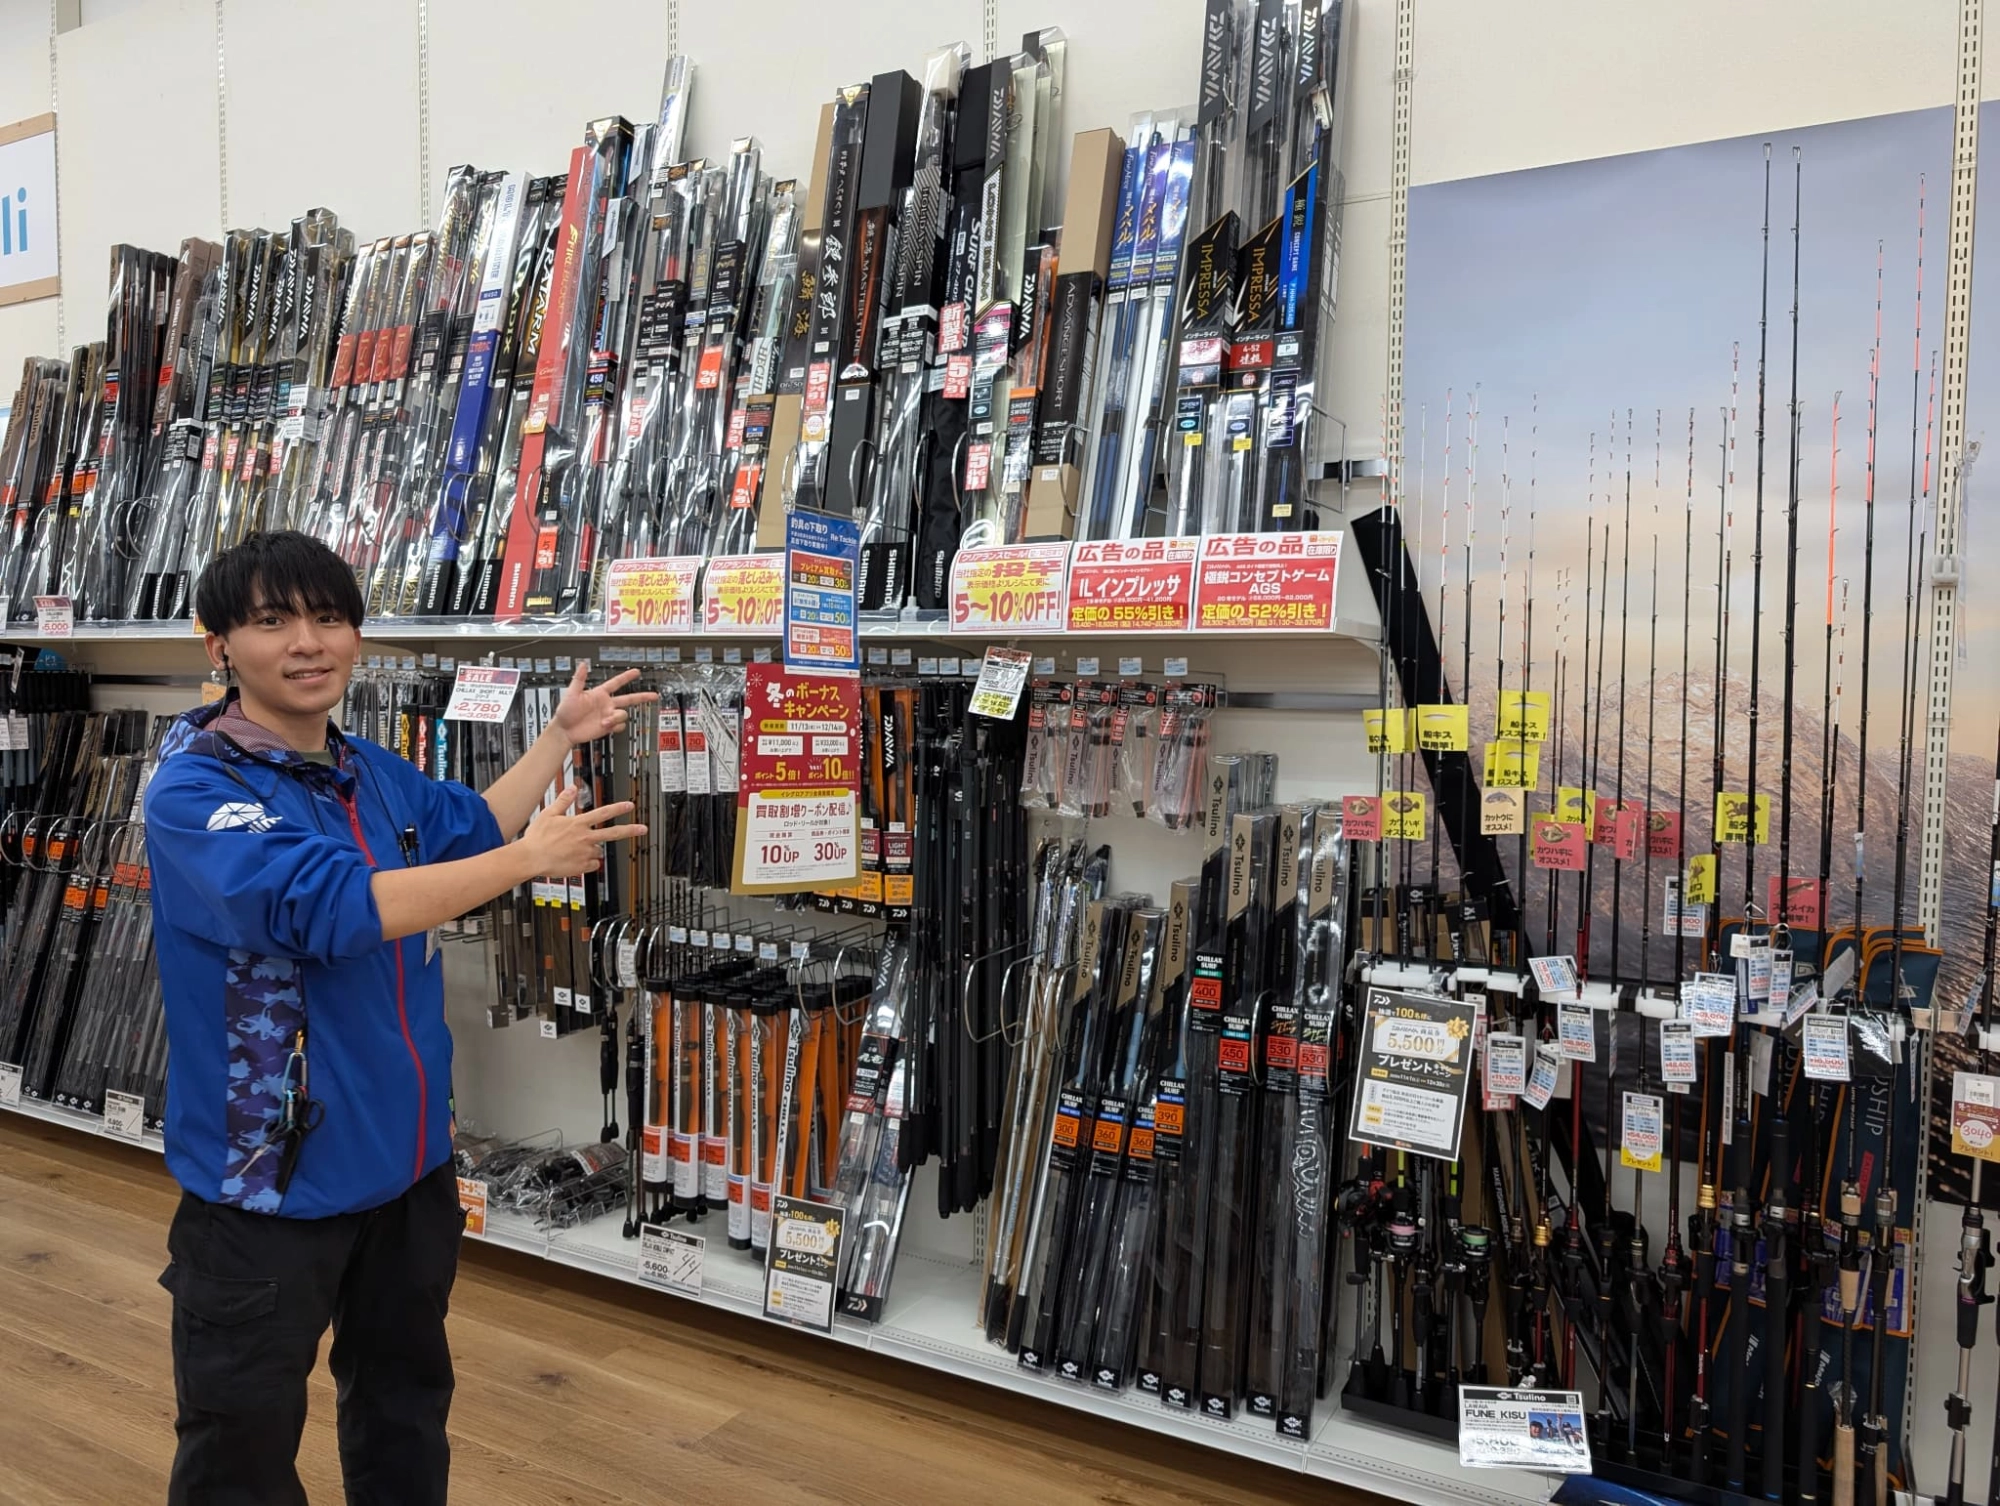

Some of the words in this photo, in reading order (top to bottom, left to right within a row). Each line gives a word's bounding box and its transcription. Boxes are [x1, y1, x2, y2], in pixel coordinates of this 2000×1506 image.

[967, 218, 981, 272] SURF
[1197, 243, 1214, 320] IMPRESSA
[1248, 248, 1266, 323] IMPRESSA
[1077, 541, 1164, 562] 広告の品
[1205, 536, 1303, 556] 広告の品
[885, 549, 897, 604] SHIMANO
[934, 550, 945, 599] SHIMANO
[1204, 569, 1329, 584] 極鋭コンセプトゲーム
[428, 564, 441, 608] SHIMANO
[480, 564, 493, 610] SHIMANO
[508, 562, 521, 608] SHIMANO
[1079, 578, 1093, 598] IL
[1096, 575, 1181, 598] インプレッサ
[1248, 582, 1281, 595] AGS
[1071, 607, 1110, 621] 定価の
[1113, 605, 1184, 620] 55%引き！
[1202, 604, 1244, 619] 定価の
[1249, 603, 1327, 618] 52%引き！
[465, 674, 492, 682] SALE
[766, 682, 840, 708] 冬のボーナス
[784, 700, 849, 719] キャンペーン
[394, 710, 402, 748] Tsulino
[1423, 730, 1453, 739] 船キス
[438, 742, 446, 781] Tsulino
[1209, 795, 1222, 837] Tsulino
[1536, 847, 1573, 857] カワハギに
[1232, 849, 1245, 896] Tsulino
[1281, 846, 1293, 887] Tsulino
[1170, 921, 1182, 962] Tsulino
[1196, 955, 1223, 963] CHILLAX
[1195, 986, 1216, 997] 400
[1271, 1005, 1299, 1014] CHILLAX
[1223, 1016, 1250, 1025] CHILLAX
[1269, 1045, 1290, 1056] 530
[1387, 1033, 1434, 1052] 5,500
[1222, 1049, 1244, 1059] 450
[1302, 1053, 1324, 1064] 530
[784, 1044, 799, 1092] Tsulino
[1378, 1055, 1432, 1072] プレゼント
[1160, 1080, 1185, 1089] CHILLAX
[1061, 1093, 1083, 1103] CHILLAX
[1101, 1099, 1126, 1109] CHILLAX
[1158, 1111, 1178, 1122] 390
[1056, 1122, 1074, 1135] 300
[1096, 1129, 1115, 1140] 360
[1961, 1125, 1993, 1140] 3040
[1133, 1136, 1152, 1148] 360
[786, 1232, 817, 1248] 5,500
[780, 1249, 815, 1264] プレゼント
[1513, 1392, 1546, 1402] Tsulino
[1465, 1409, 1495, 1418] FUNE
[1501, 1410, 1527, 1420] KISU
